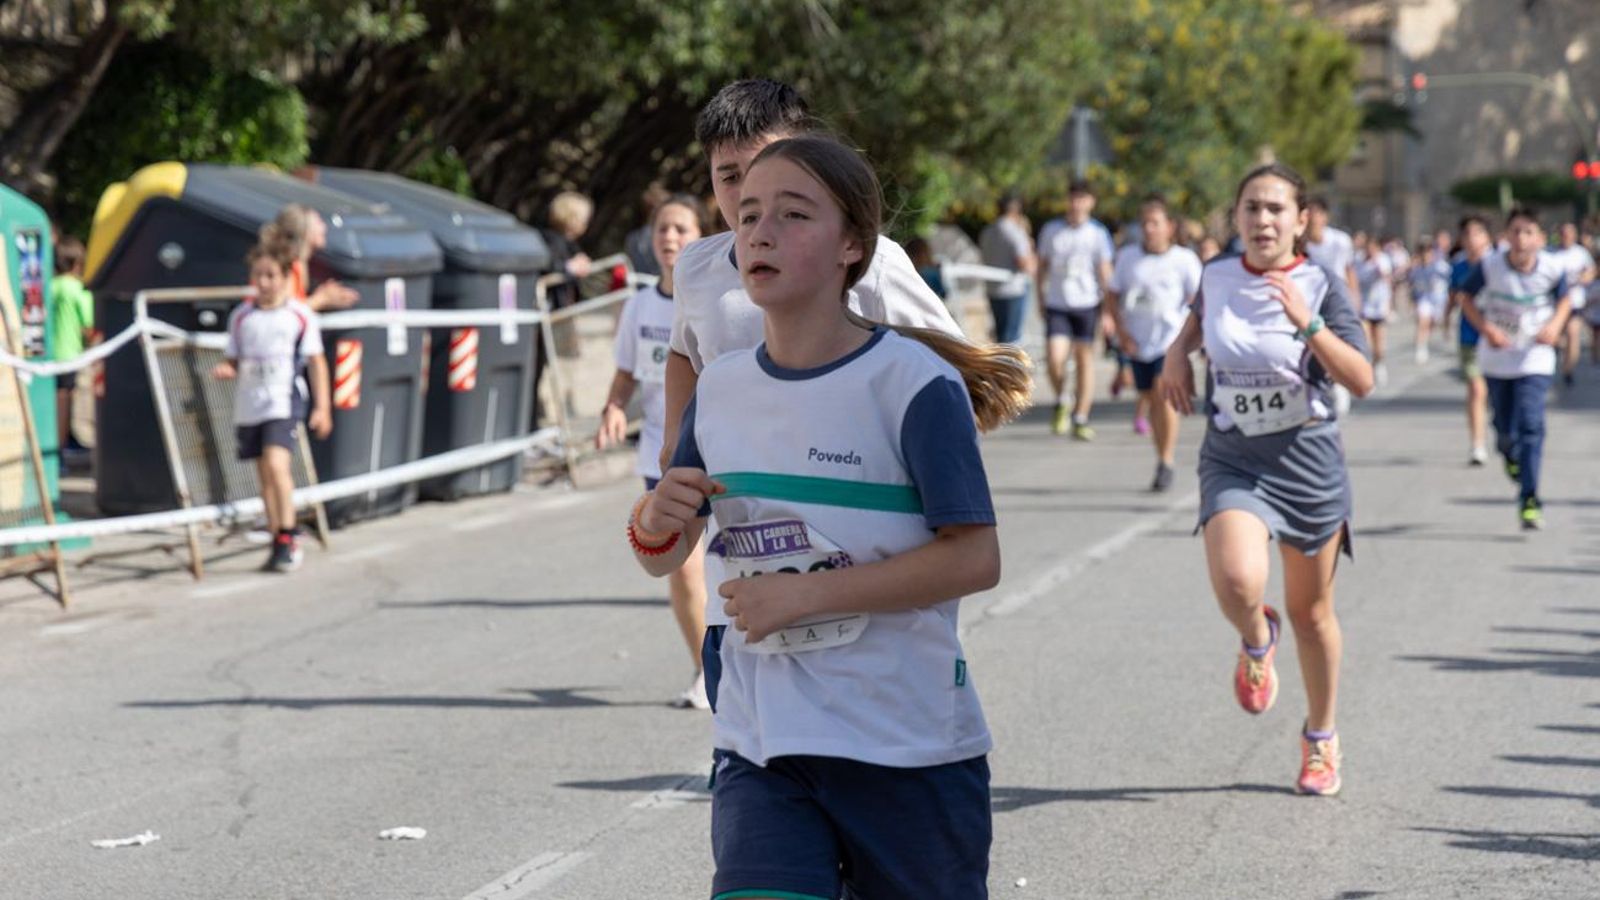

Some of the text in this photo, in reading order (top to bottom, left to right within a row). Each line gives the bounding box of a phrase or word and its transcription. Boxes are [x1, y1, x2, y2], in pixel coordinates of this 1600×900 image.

[1234, 391, 1285, 414] 814
[808, 447, 862, 466] Poveda
[772, 537, 787, 550] LA
